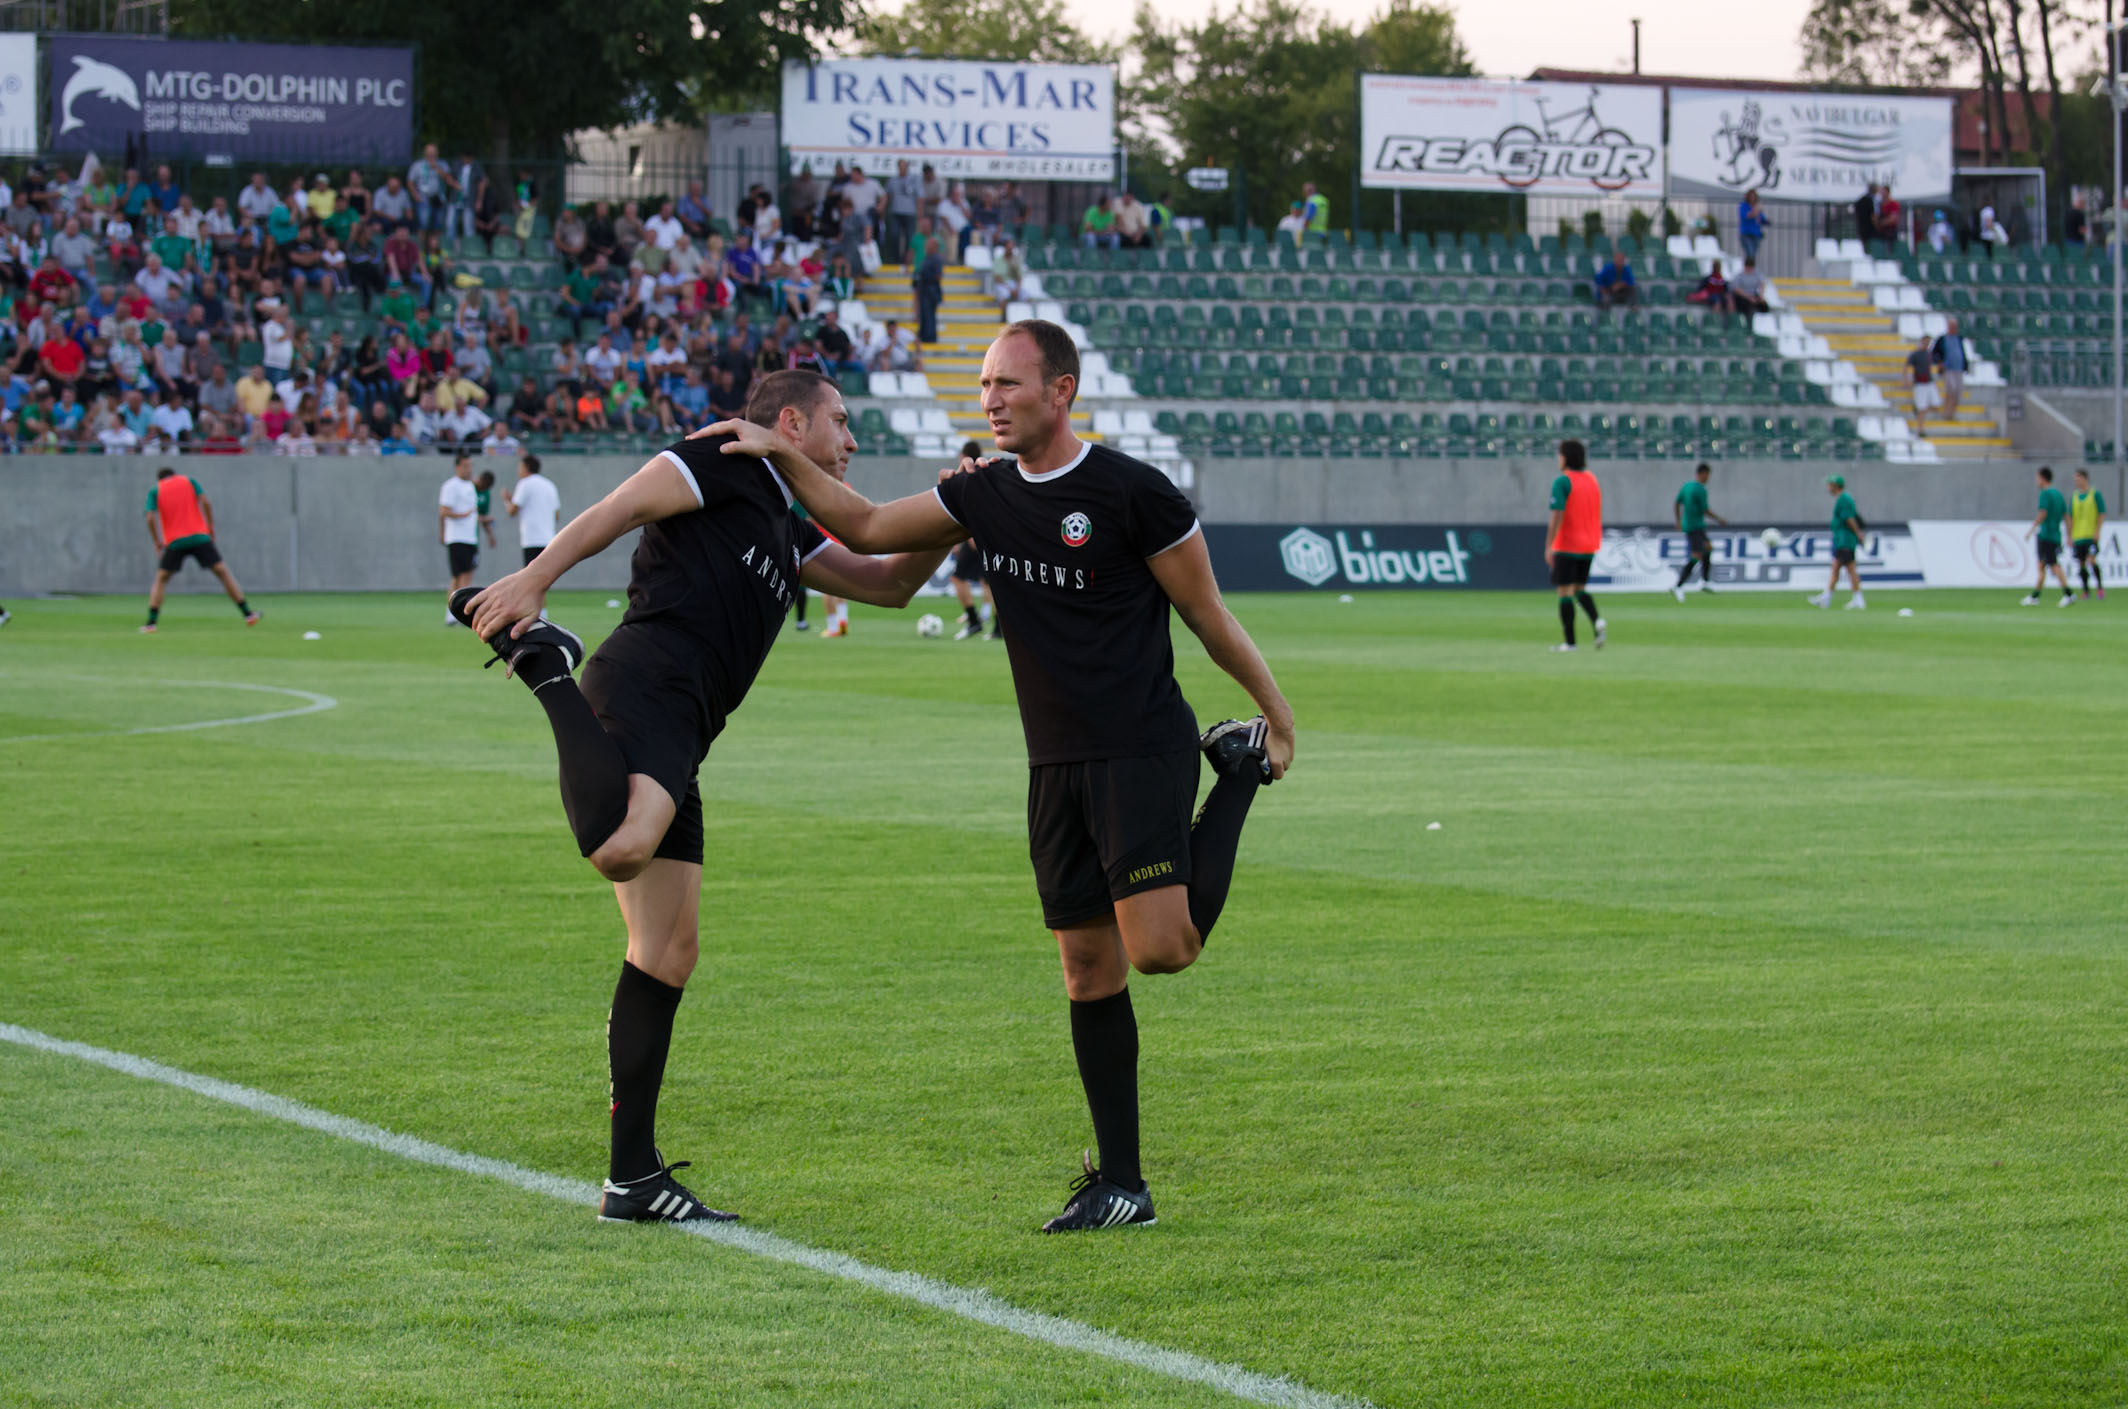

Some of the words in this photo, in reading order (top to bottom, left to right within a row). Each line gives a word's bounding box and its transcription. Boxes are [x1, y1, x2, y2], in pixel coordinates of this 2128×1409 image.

[145, 70, 348, 105] MTG-DOLPHIN
[356, 78, 406, 107] PLC
[796, 64, 1099, 112] TRANS-MAR
[143, 102, 178, 116] SHIP
[180, 103, 230, 119] REPAIR
[232, 104, 327, 123] CONVERSION
[143, 117, 178, 132] SHIP
[180, 118, 250, 135] BUILDING
[848, 110, 1051, 151] SERVICES
[1790, 104, 1900, 125] NAVIBULGAR
[1374, 135, 1656, 181] REACTOR
[1335, 530, 1471, 584] biovet
